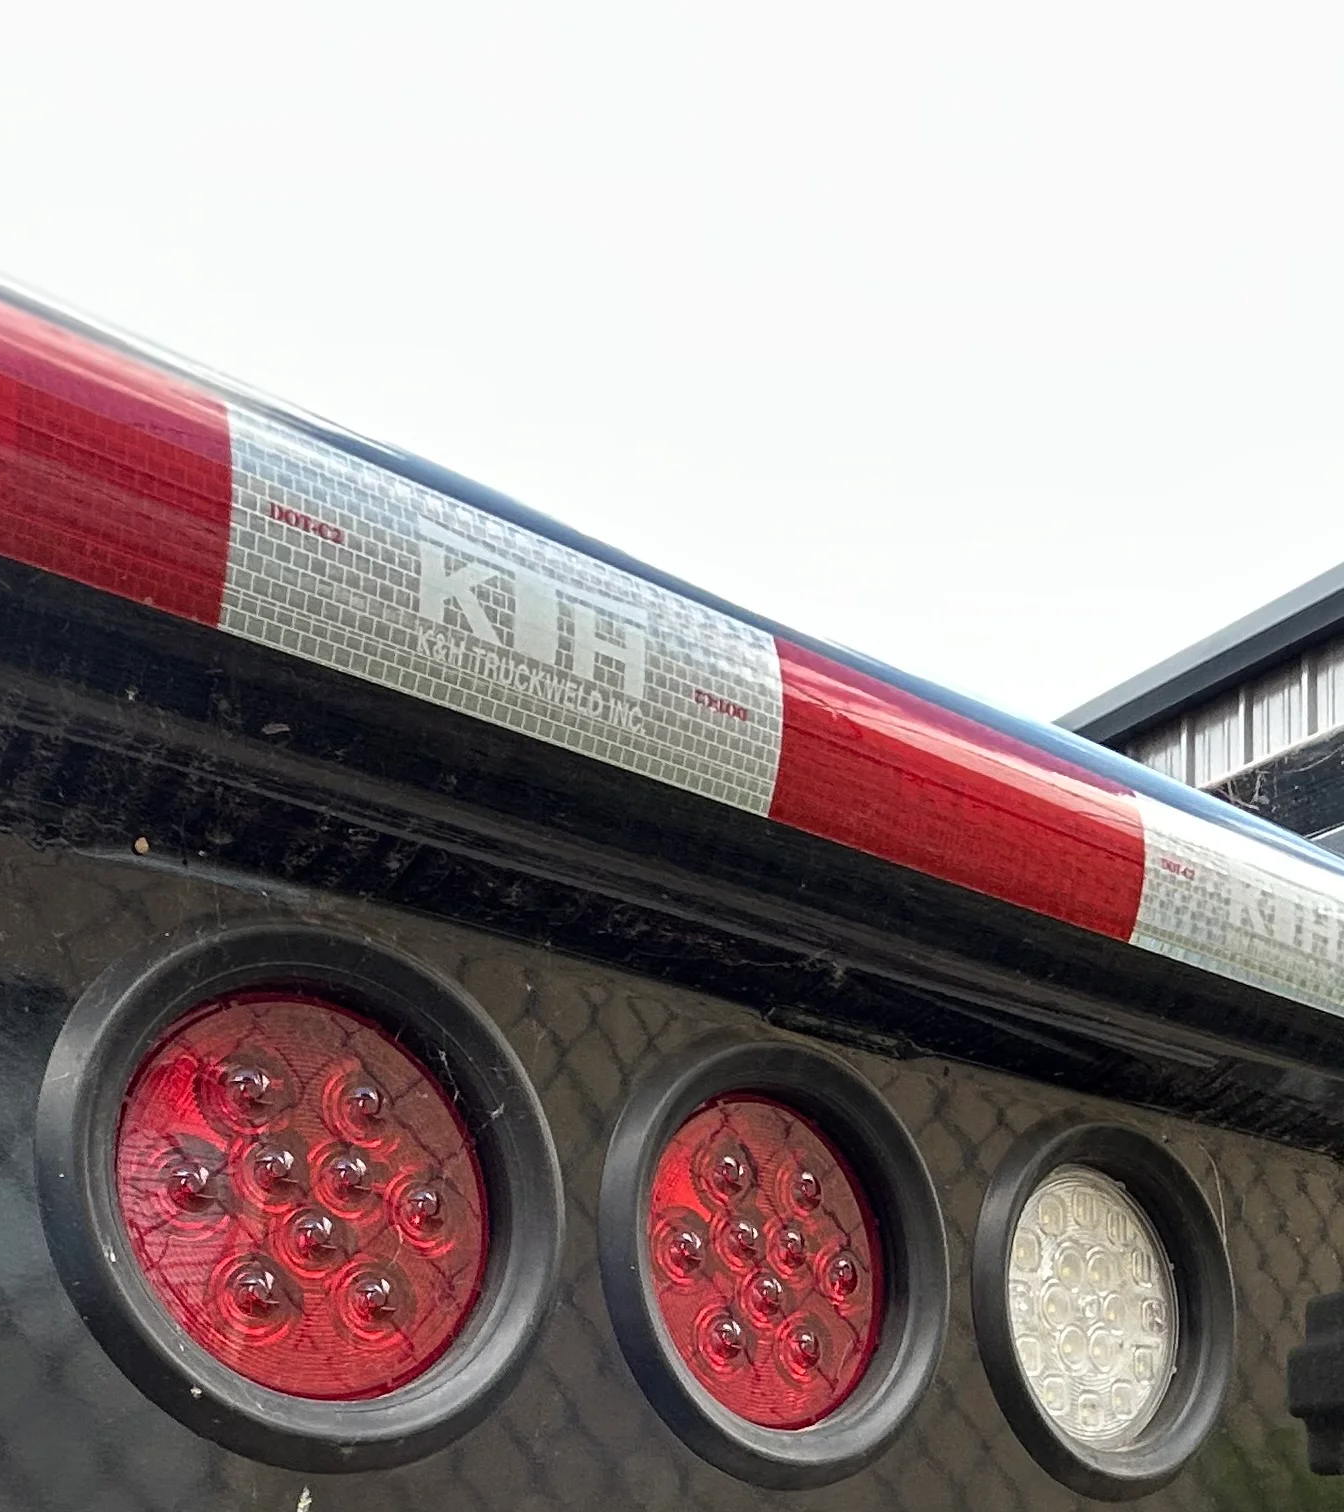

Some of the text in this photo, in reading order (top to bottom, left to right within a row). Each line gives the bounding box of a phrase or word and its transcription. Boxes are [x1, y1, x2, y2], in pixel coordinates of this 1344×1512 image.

[267, 501, 344, 544] DOT-C2
[418, 514, 649, 700] KTH
[417, 625, 648, 736] K&H TRUCKWELD INC.
